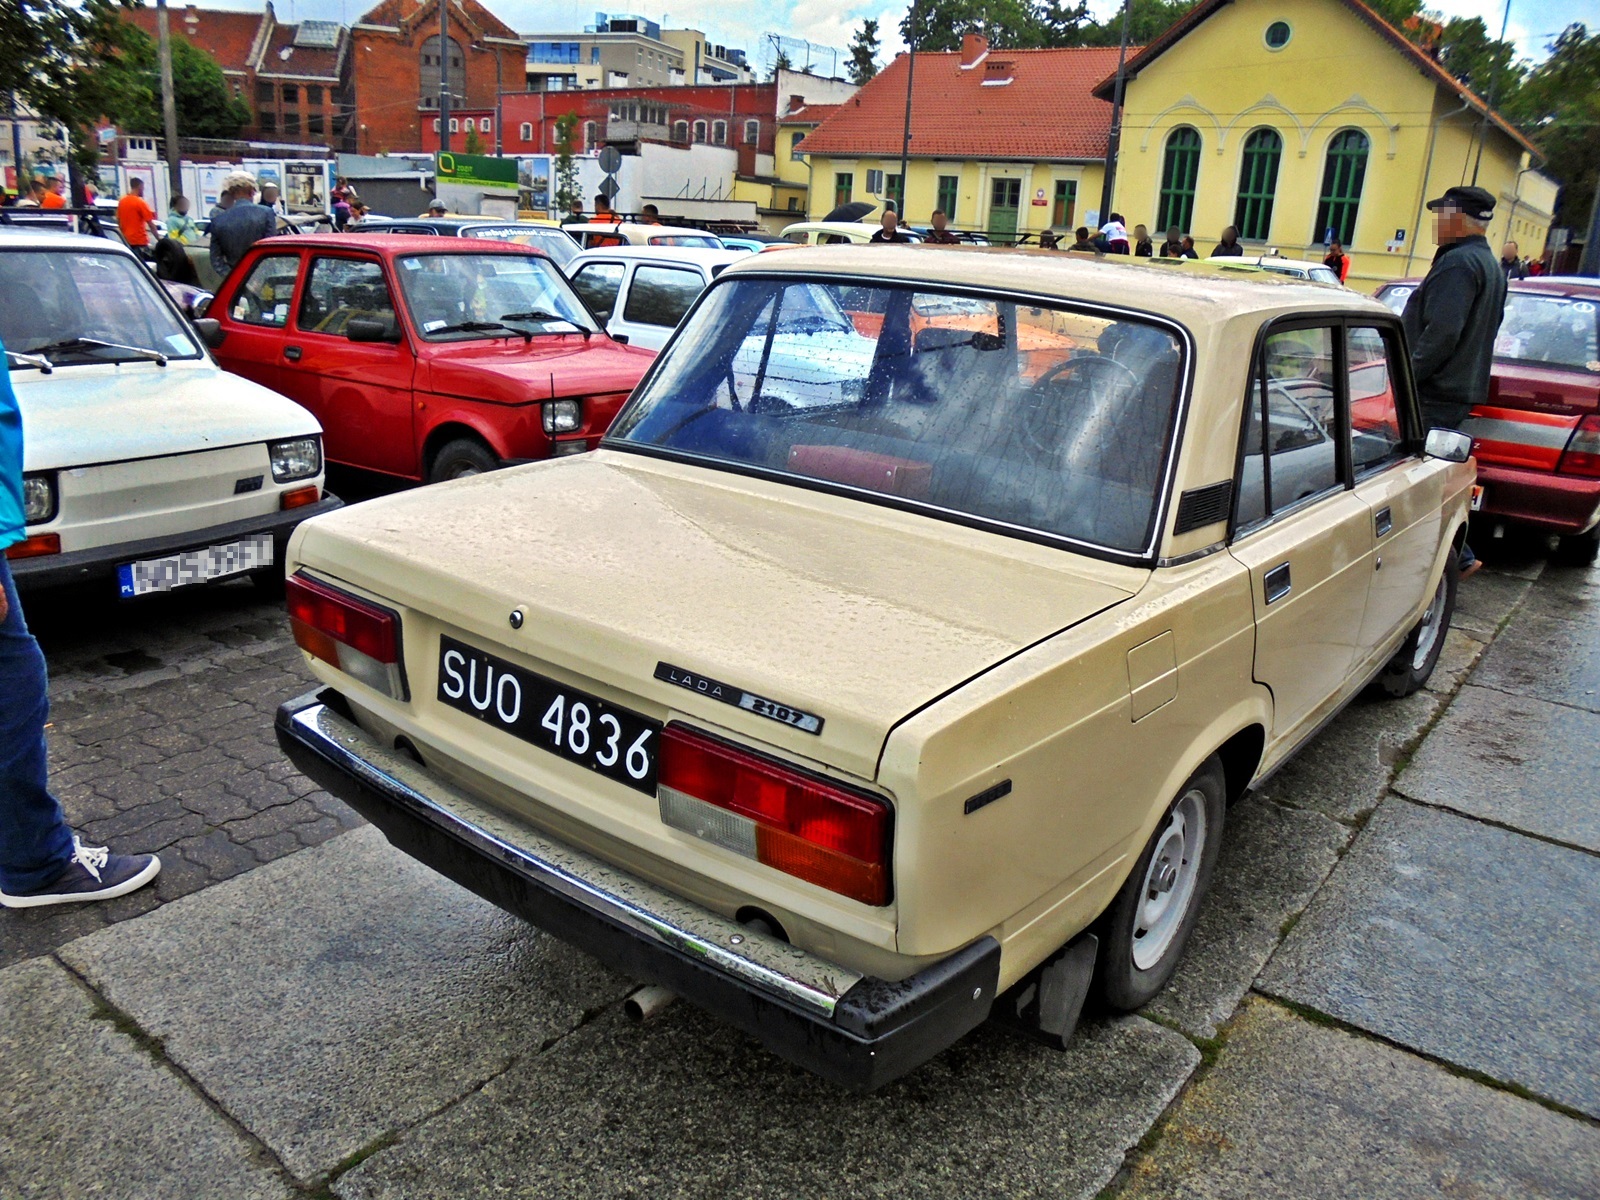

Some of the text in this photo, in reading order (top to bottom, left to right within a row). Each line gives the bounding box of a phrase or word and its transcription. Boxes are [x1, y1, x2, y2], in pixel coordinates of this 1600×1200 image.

[121, 585, 132, 593] PL
[442, 650, 653, 779] SUO 4836
[670, 670, 804, 724] LADA 2107
